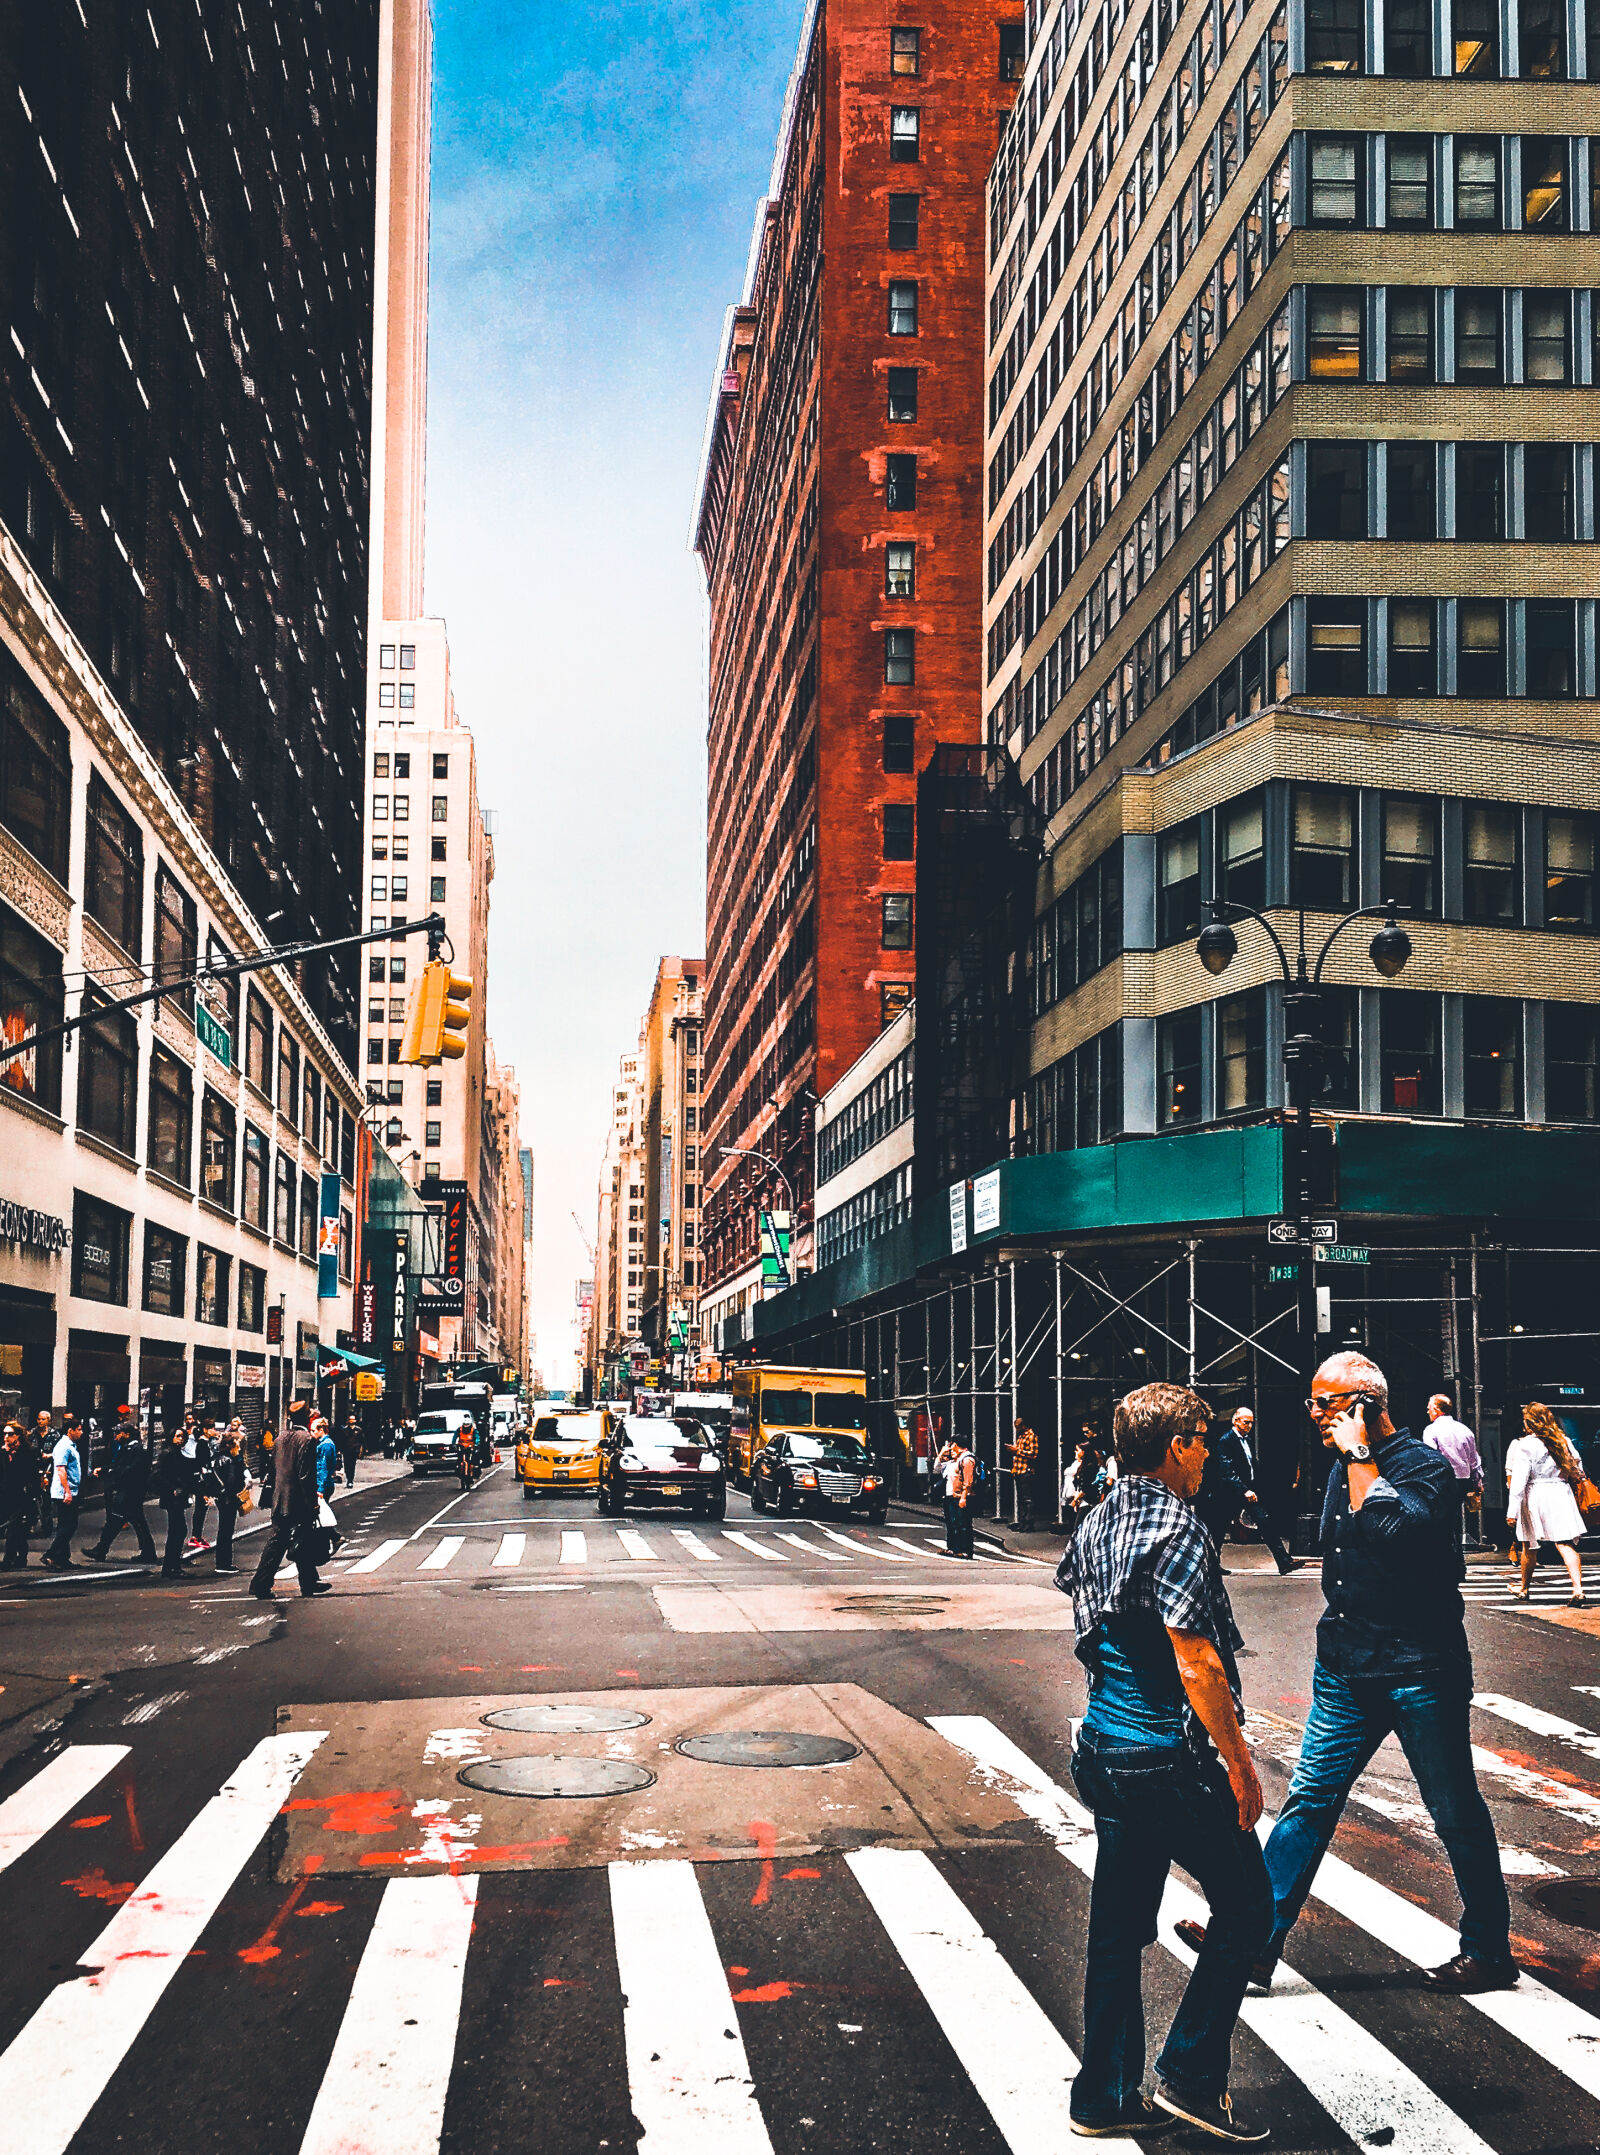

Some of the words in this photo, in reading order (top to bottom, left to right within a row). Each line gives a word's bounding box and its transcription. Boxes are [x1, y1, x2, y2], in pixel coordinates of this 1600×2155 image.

[32, 1210, 63, 1252] DRUGS
[1275, 1227, 1297, 1237] ONE
[1325, 1247, 1369, 1262] BROADWAY
[1282, 1266, 1292, 1279] 38
[394, 1252, 406, 1338] PARK
